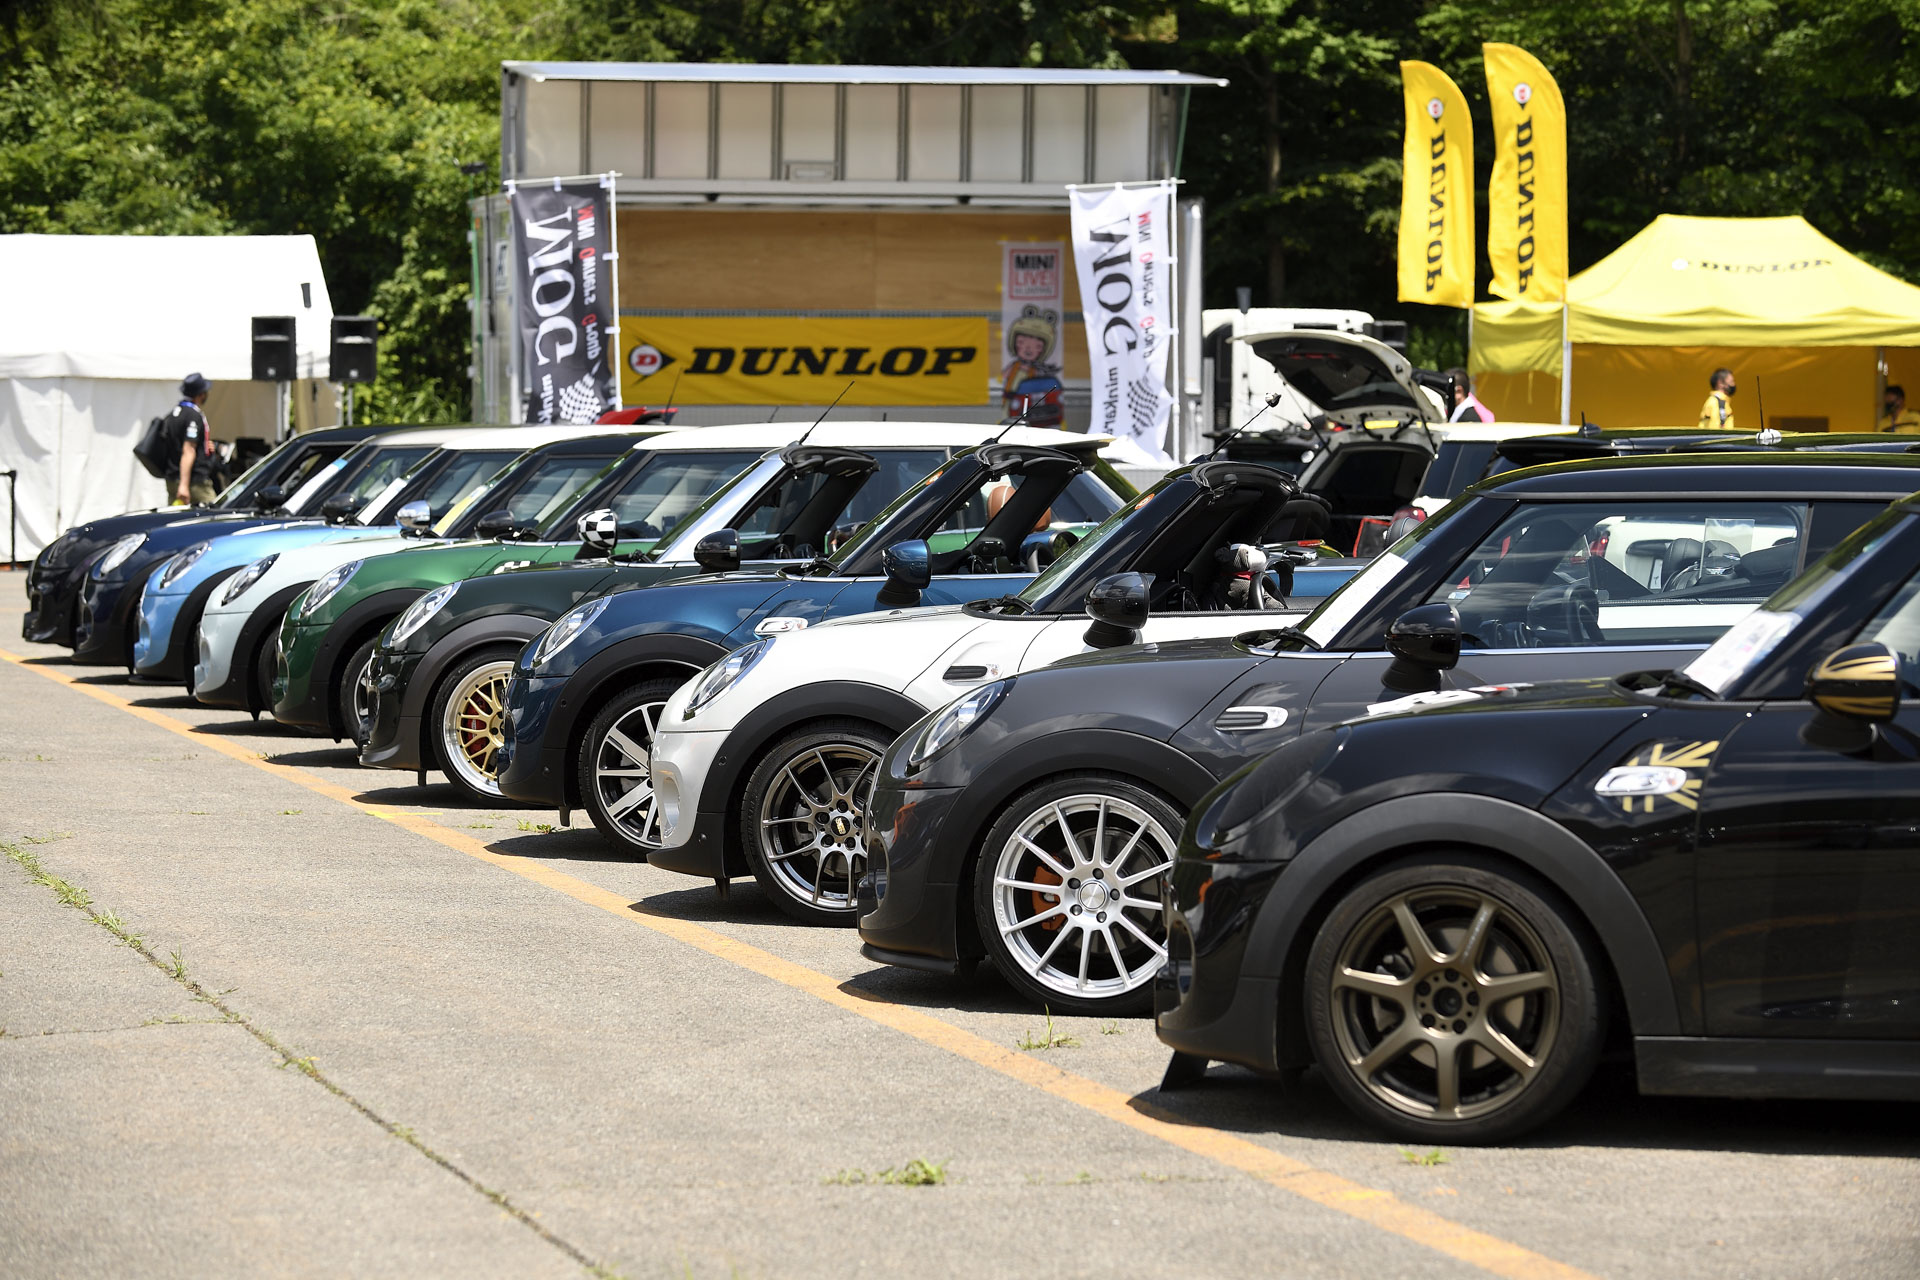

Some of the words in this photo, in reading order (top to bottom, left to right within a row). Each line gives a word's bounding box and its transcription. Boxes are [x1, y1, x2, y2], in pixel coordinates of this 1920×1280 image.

[1014, 254, 1054, 270] MINI
[1701, 258, 1832, 273] DUNLOP
[684, 347, 977, 376] DUNLOP
